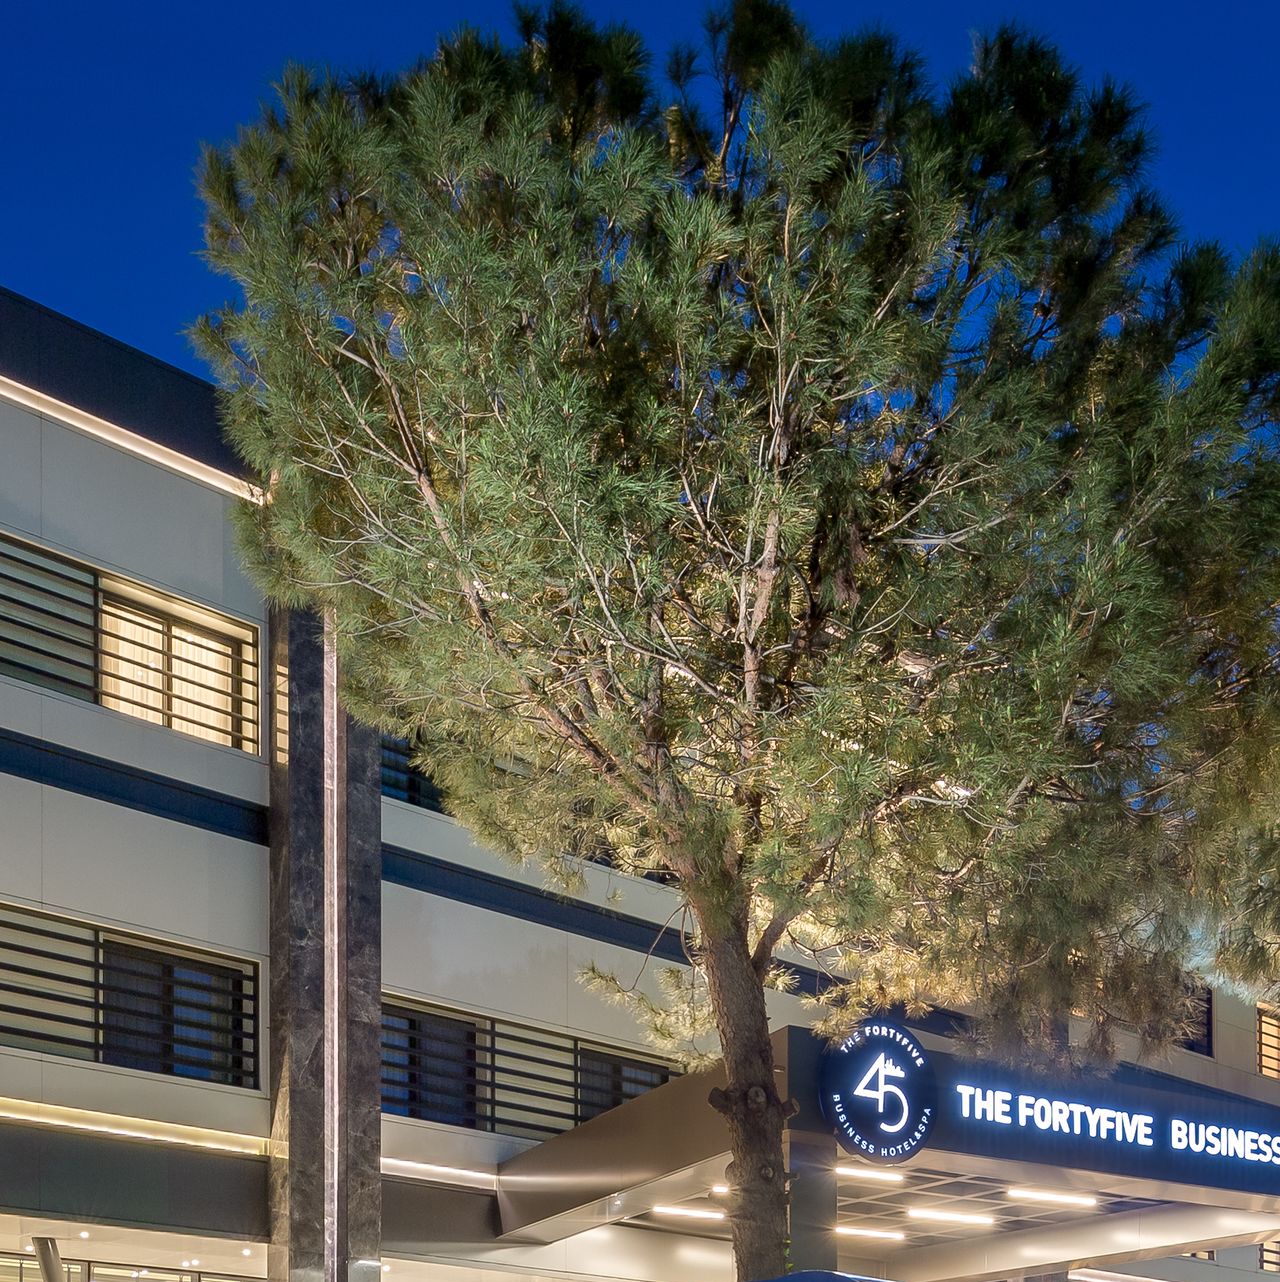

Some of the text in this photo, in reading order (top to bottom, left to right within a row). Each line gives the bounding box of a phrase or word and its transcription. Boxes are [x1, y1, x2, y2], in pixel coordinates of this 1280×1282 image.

[840, 1031, 860, 1053] THE
[865, 1025, 924, 1067] FORTYFIVE
[853, 1052, 909, 1133] 45
[956, 1084, 1012, 1124] THE
[1018, 1095, 1154, 1146] FORTYFIVE
[833, 1094, 875, 1154] BUSINESS
